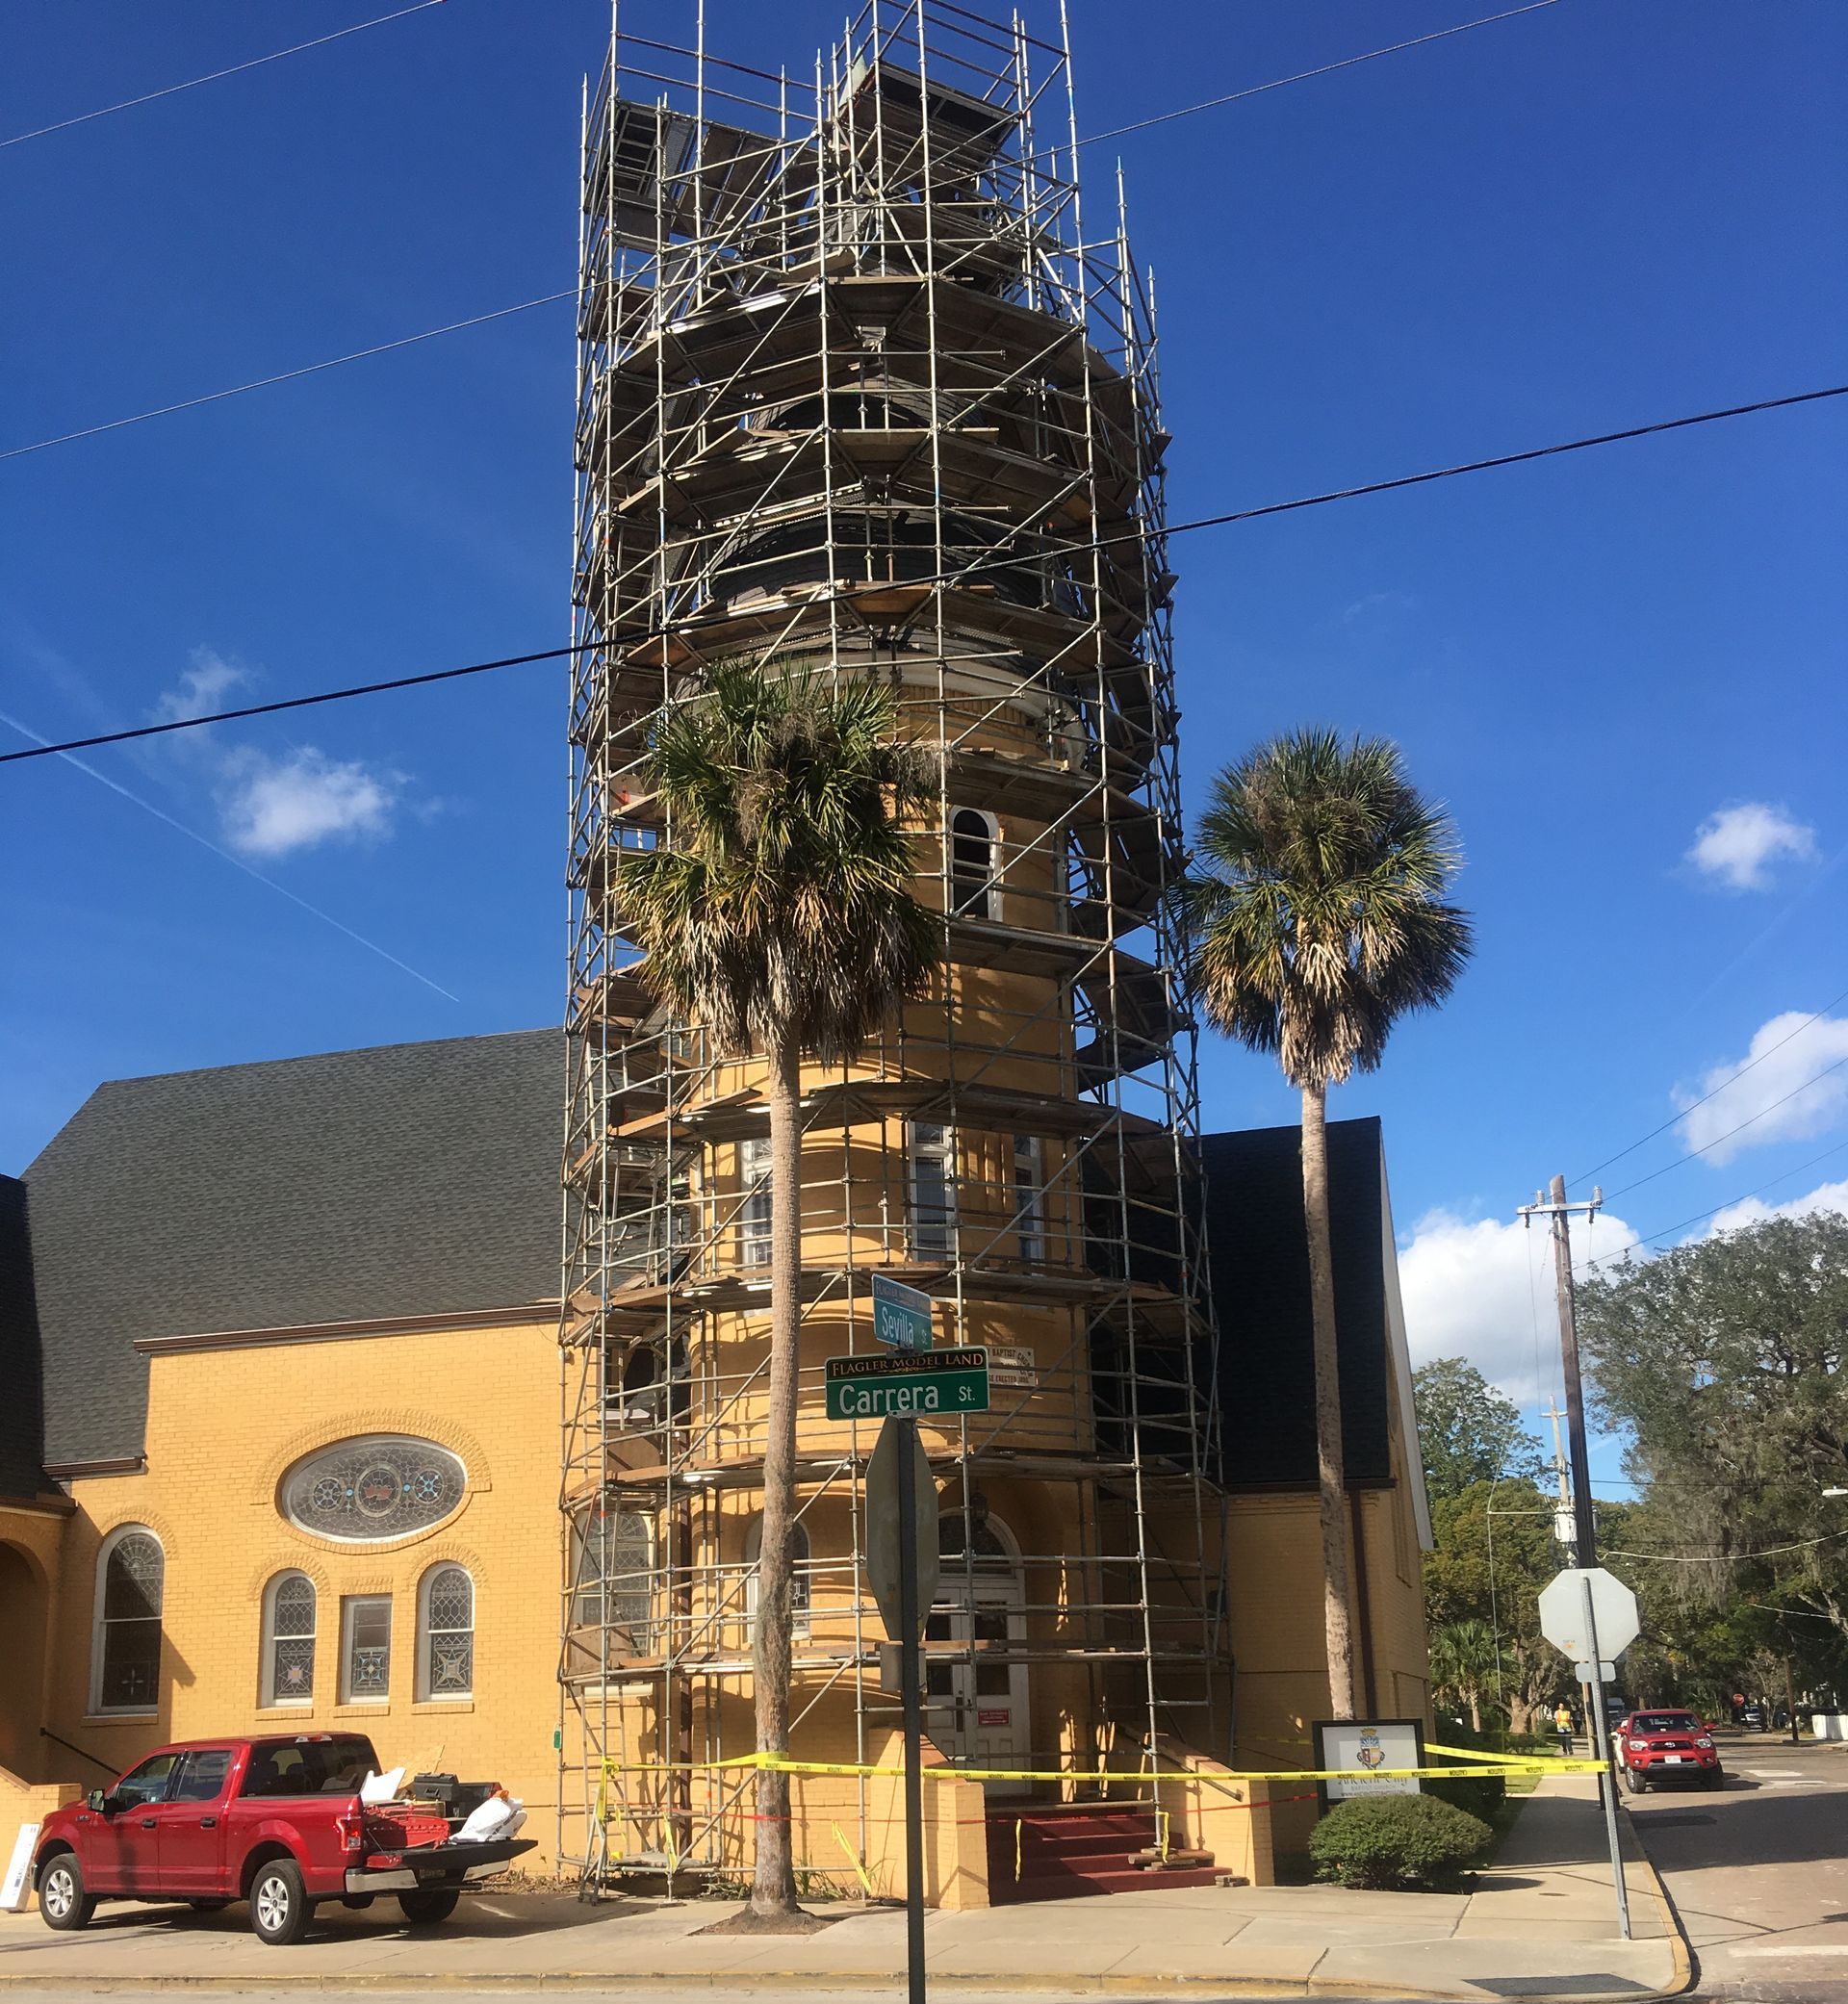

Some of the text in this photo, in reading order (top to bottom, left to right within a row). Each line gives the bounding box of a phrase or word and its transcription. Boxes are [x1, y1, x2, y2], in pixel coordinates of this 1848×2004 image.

[882, 1306, 913, 1347] Sevilla
[832, 1353, 984, 1376] FLAGLER MODEL LAND
[839, 1384, 976, 1415] Carrera St.
